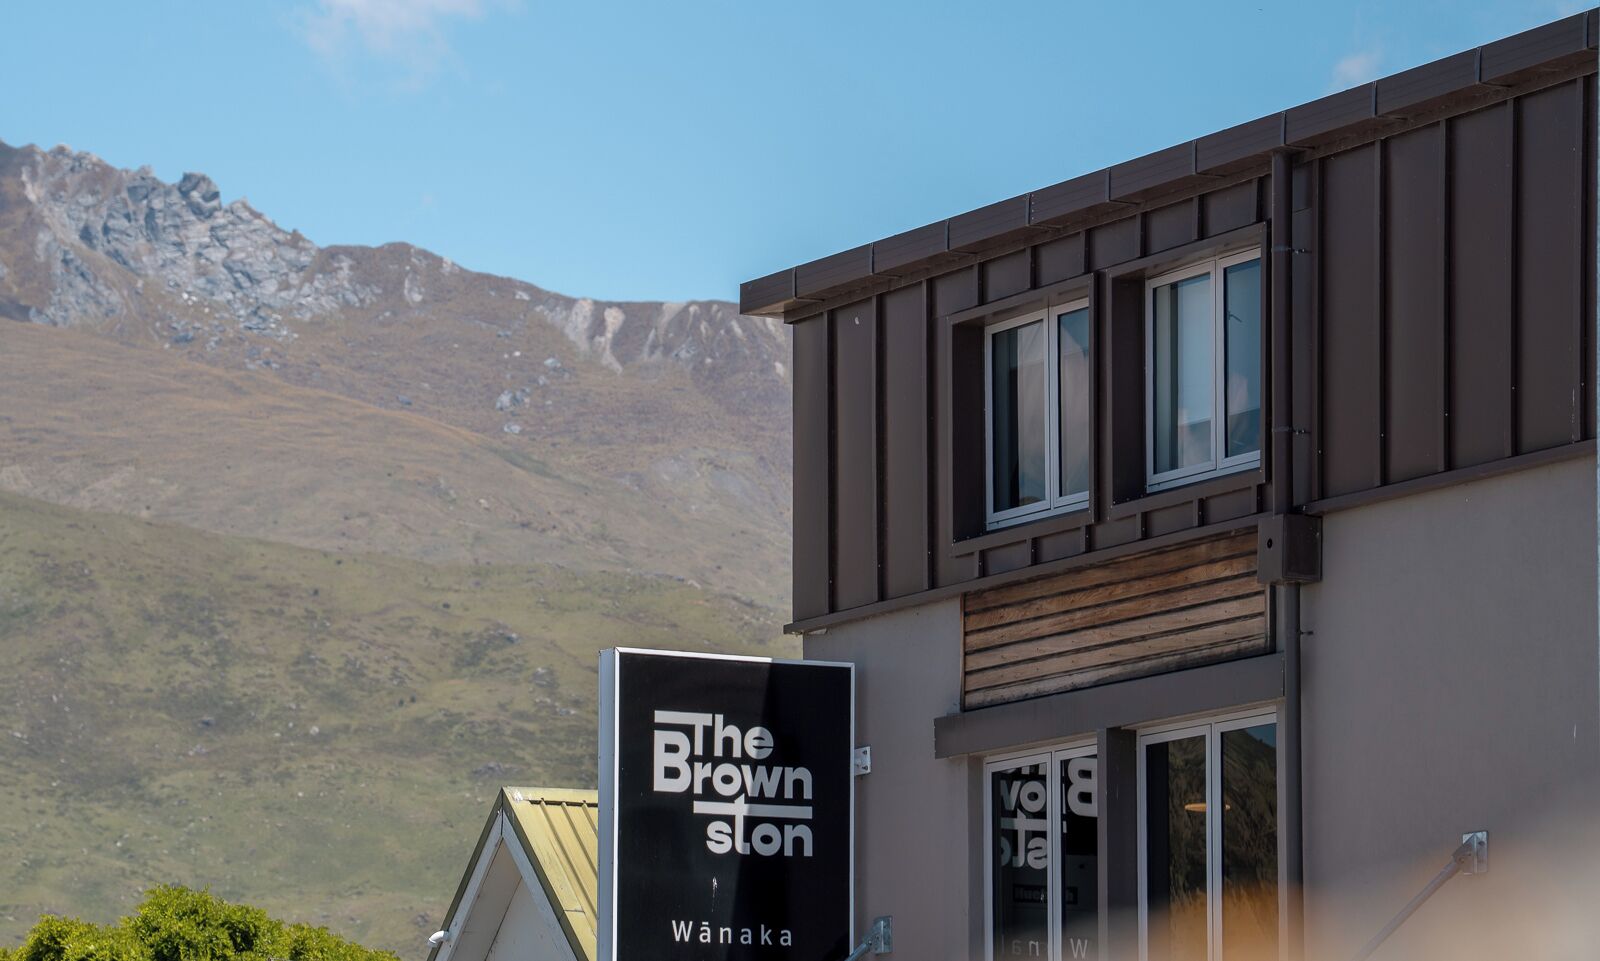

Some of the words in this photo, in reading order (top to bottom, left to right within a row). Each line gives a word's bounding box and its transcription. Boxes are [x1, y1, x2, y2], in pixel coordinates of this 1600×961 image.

[653, 709, 775, 760] The
[653, 729, 813, 800] Brown
[704, 794, 813, 857] ston
[671, 919, 792, 946] Wānaka
